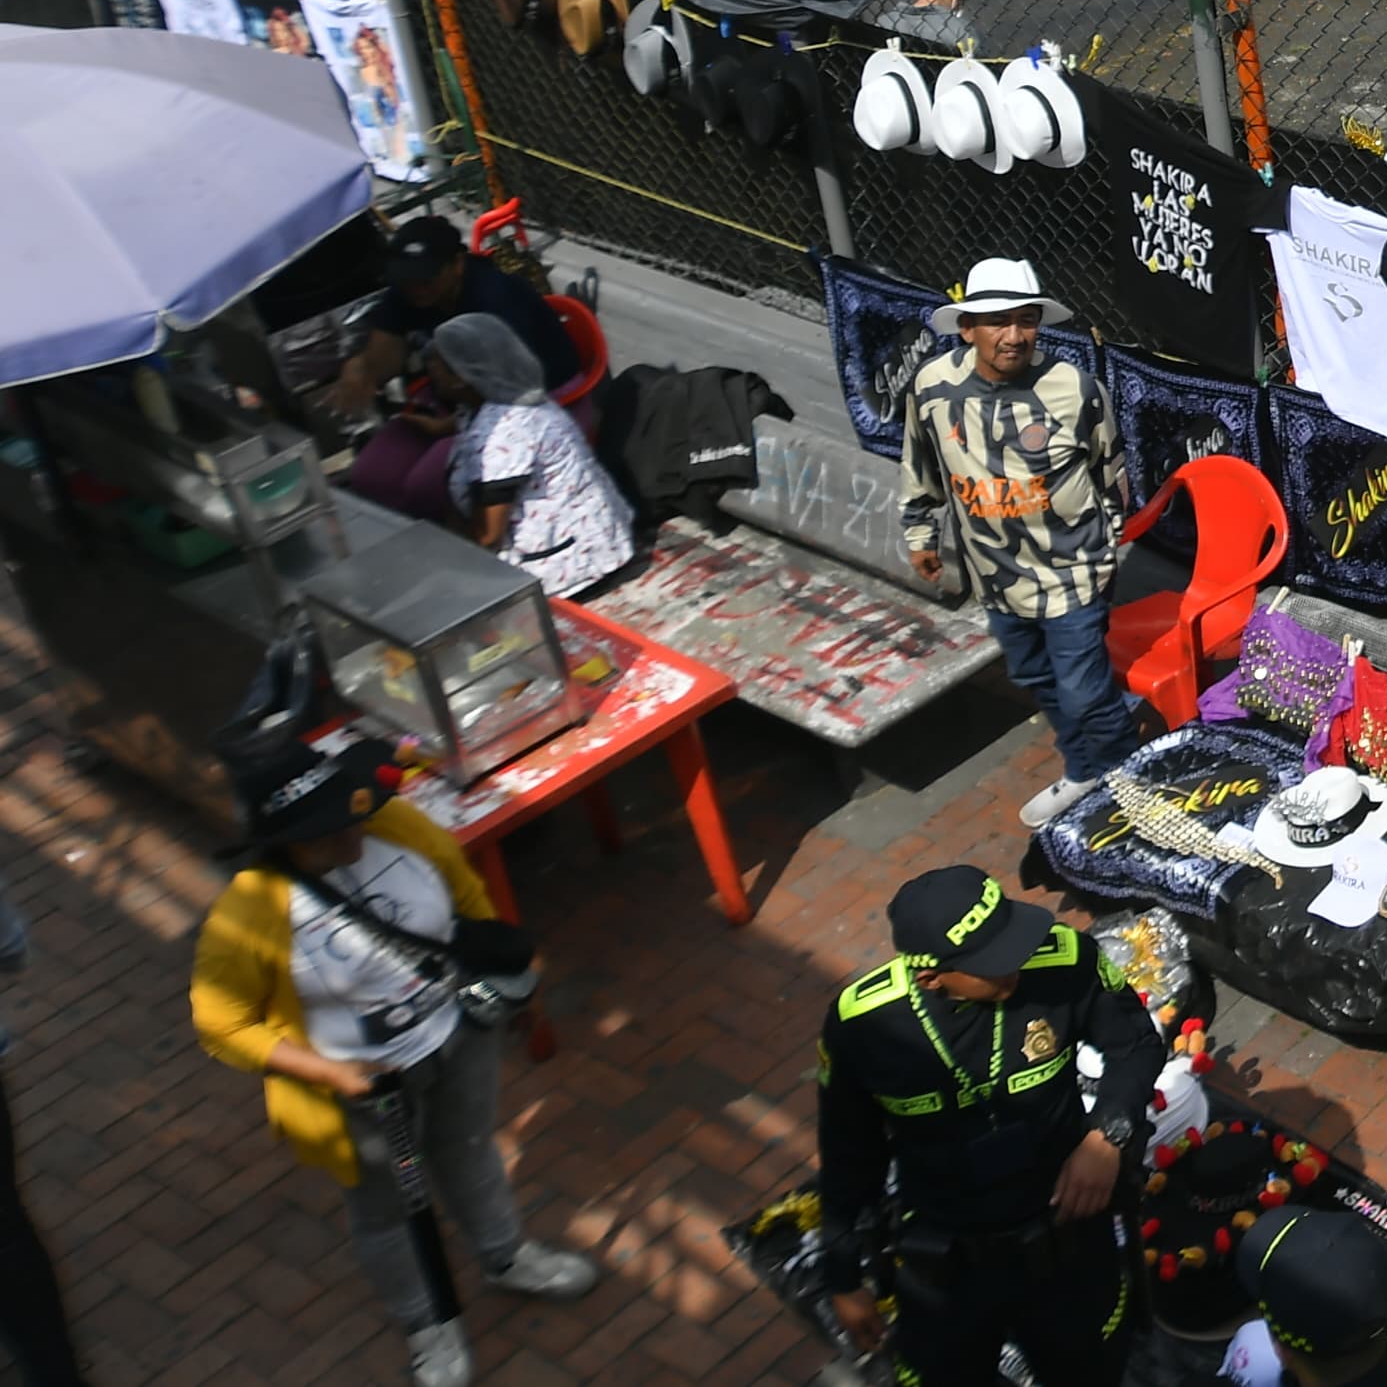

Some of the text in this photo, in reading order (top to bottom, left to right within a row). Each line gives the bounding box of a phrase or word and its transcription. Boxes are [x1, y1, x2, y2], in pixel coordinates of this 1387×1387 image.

[1130, 148, 1213, 208] SHAKIRA
[1173, 234, 1207, 268] NO
[951, 474, 1049, 504] QATAR
[969, 498, 1049, 519] AIRWAYS
[1287, 825, 1331, 844] KIRA
